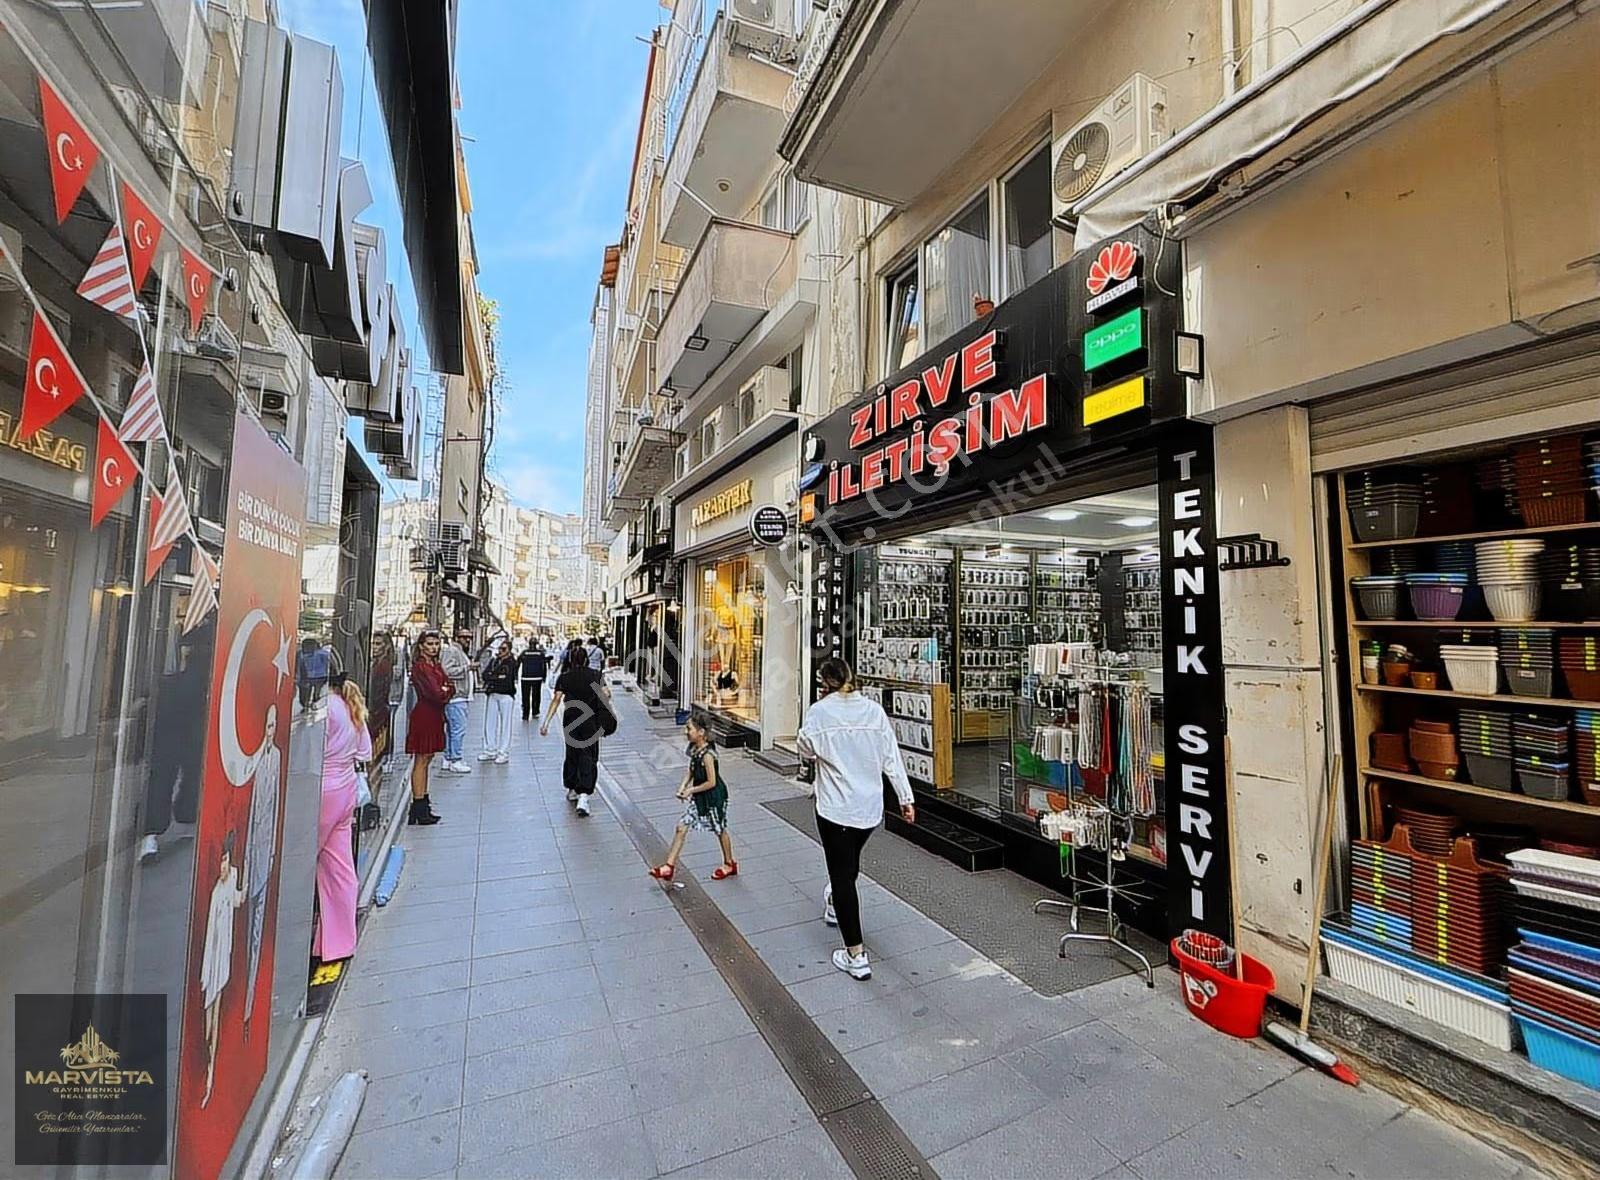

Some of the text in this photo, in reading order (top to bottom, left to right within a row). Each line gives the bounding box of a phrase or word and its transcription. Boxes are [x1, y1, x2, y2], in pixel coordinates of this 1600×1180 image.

[849, 329, 997, 449] ZİRVE
[1089, 323, 1136, 350] oppo
[828, 373, 1047, 506] İLETİŞİM
[1173, 449, 1214, 922] TEKNİK SERVİ
